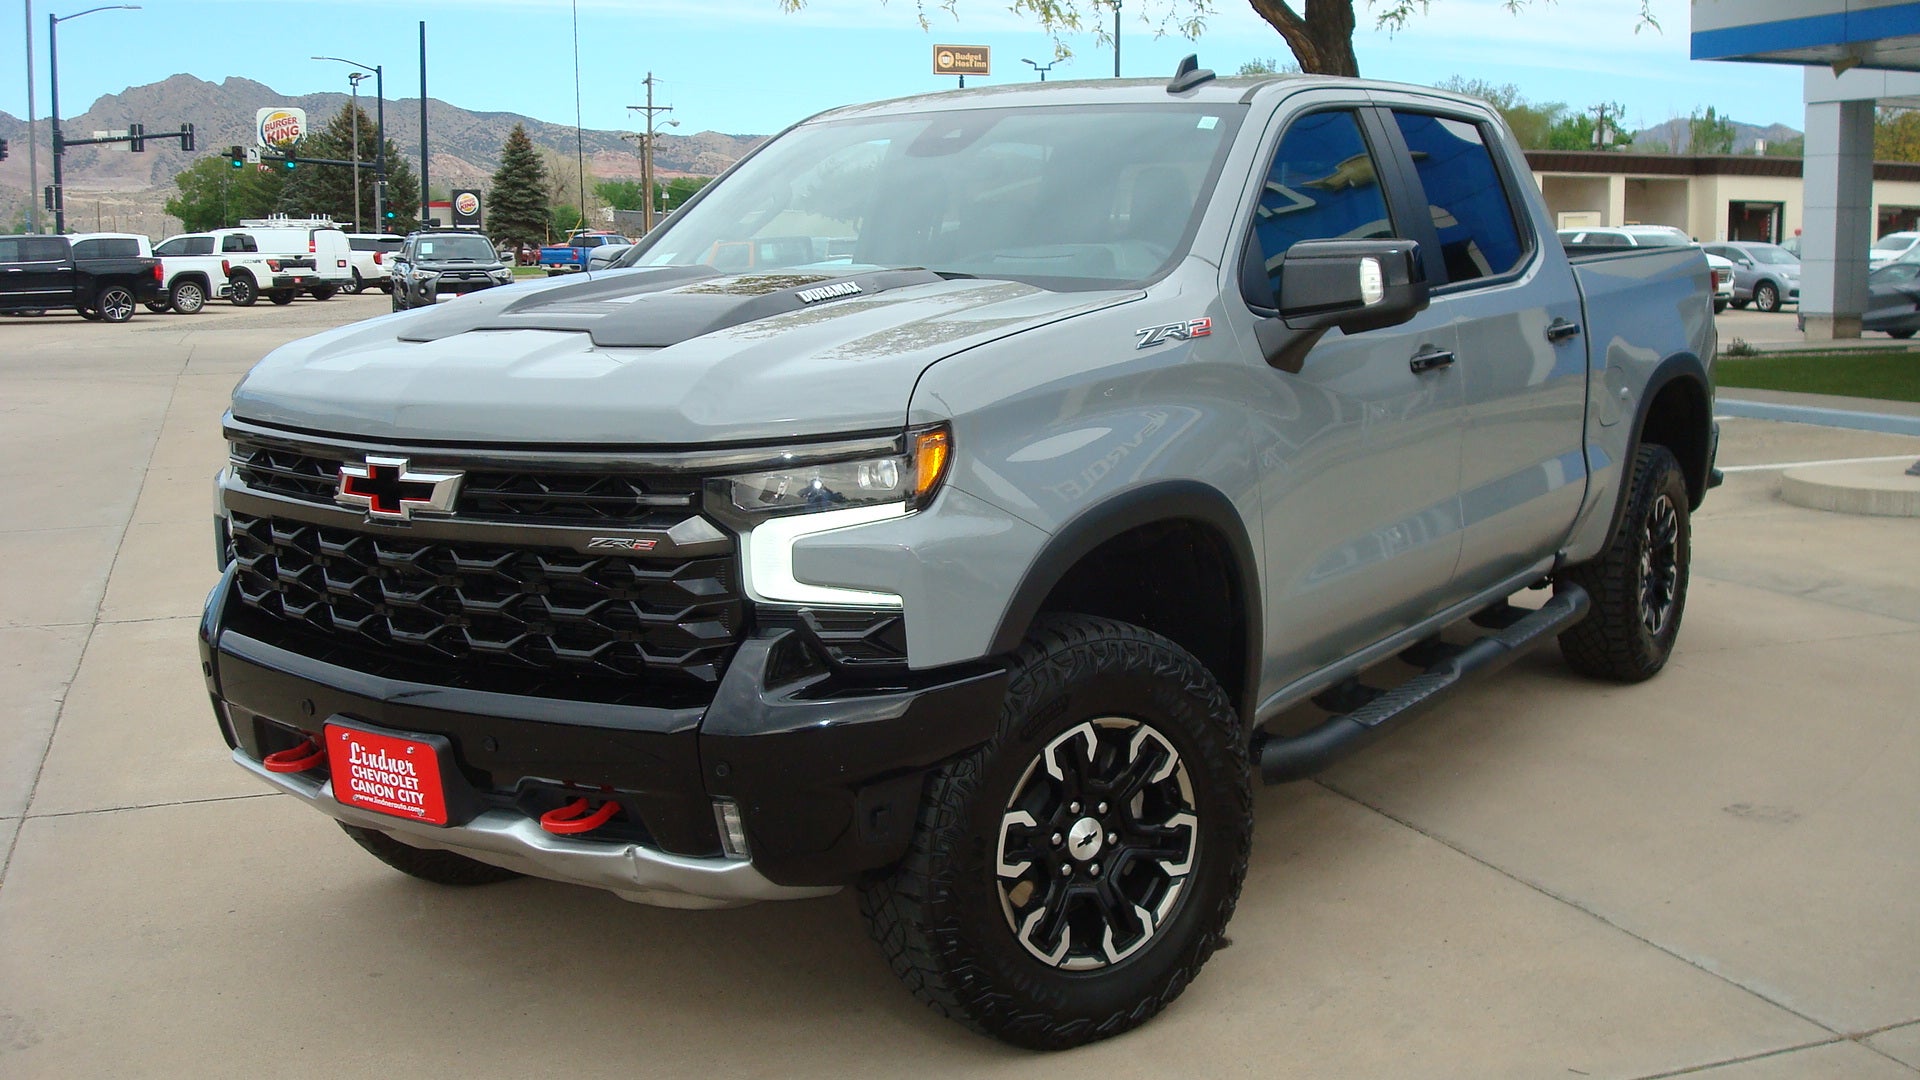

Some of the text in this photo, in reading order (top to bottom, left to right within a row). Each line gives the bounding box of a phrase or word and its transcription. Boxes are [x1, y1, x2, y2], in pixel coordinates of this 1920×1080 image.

[955, 53, 982, 61] Budget
[264, 116, 298, 132] BURGER
[267, 125, 299, 143] KING
[460, 202, 477, 210] KING
[796, 280, 863, 304] DURAMAX
[1135, 316, 1213, 350] ZR2
[586, 537, 659, 551] ZR2
[349, 742, 417, 776] Lindner
[351, 765, 419, 790] CHEVROLET
[350, 779, 425, 805] CANON CITY
